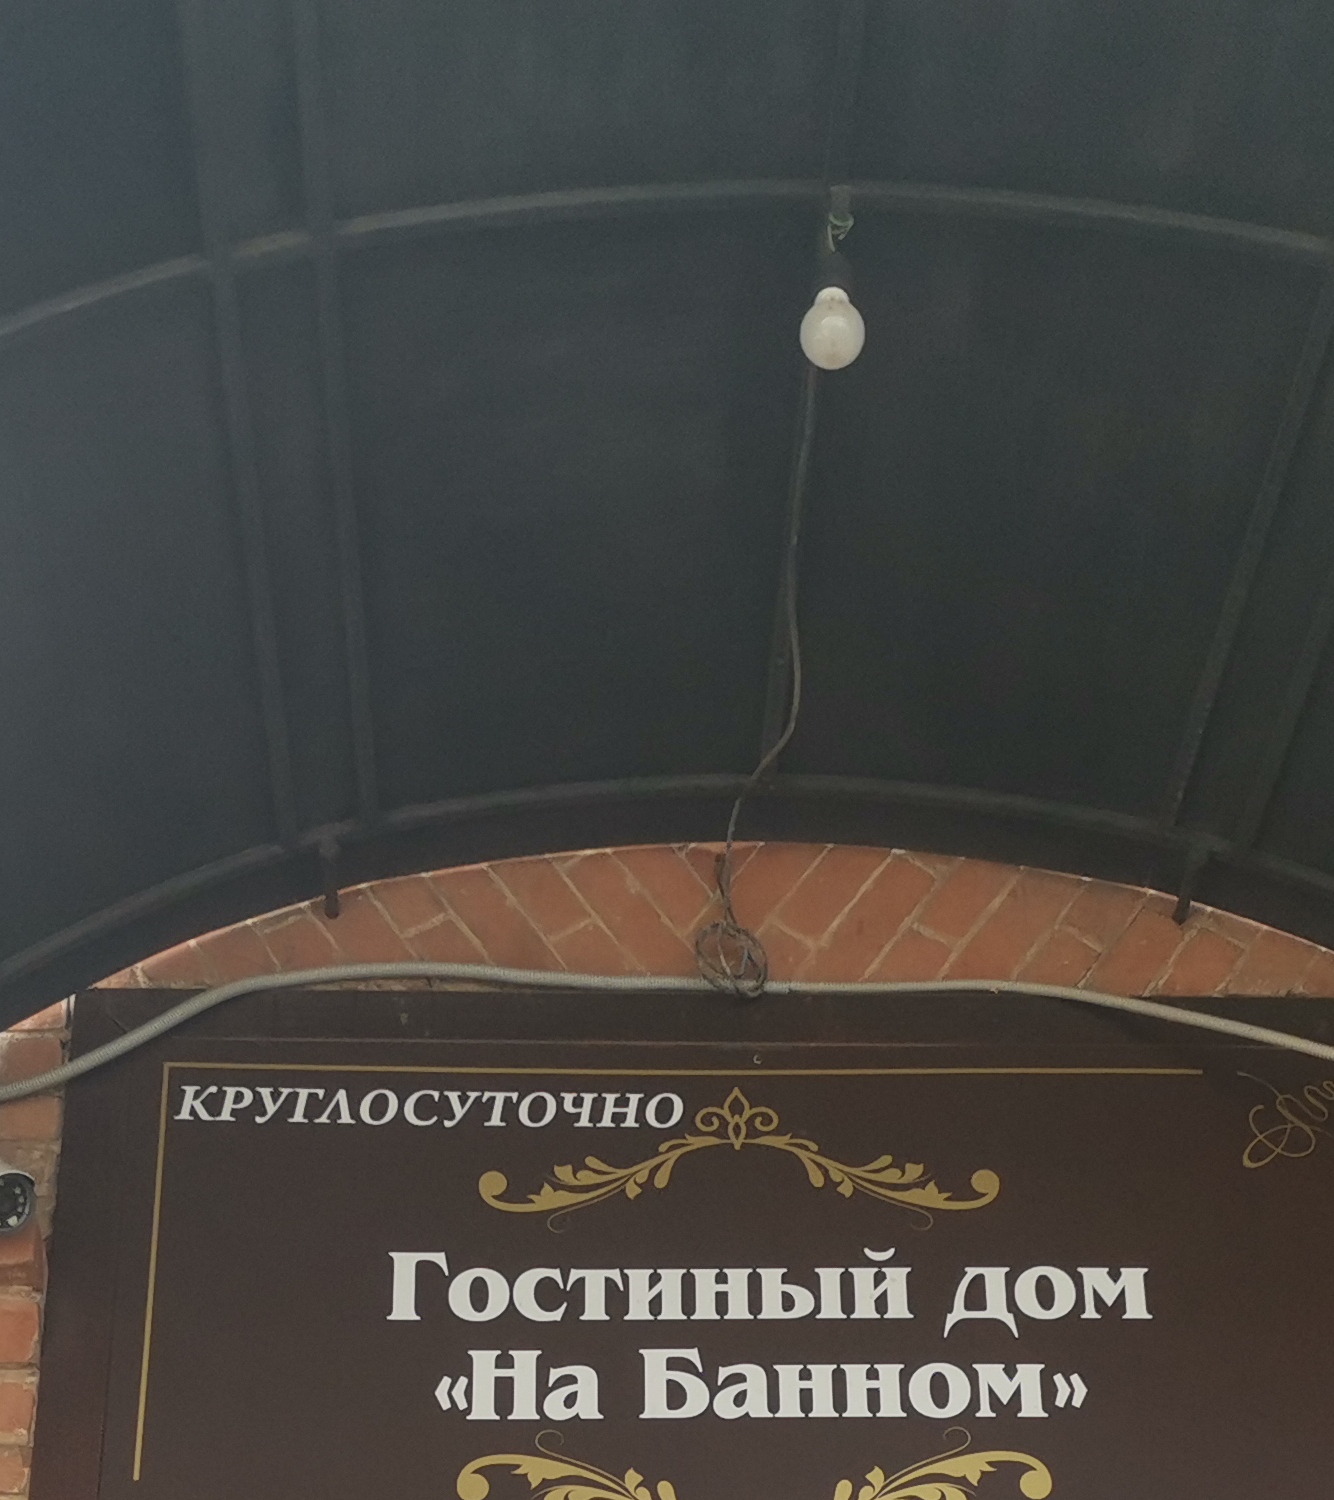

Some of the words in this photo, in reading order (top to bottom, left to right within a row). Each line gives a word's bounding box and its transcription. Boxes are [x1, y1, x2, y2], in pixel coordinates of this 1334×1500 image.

[173, 1084, 685, 1130] КРУГЛОСУТОЧНО
[385, 1246, 915, 1323] Гостиный
[942, 1264, 1154, 1339] дом
[433, 1349, 605, 1422] «На
[637, 1346, 1089, 1421] Банном»
